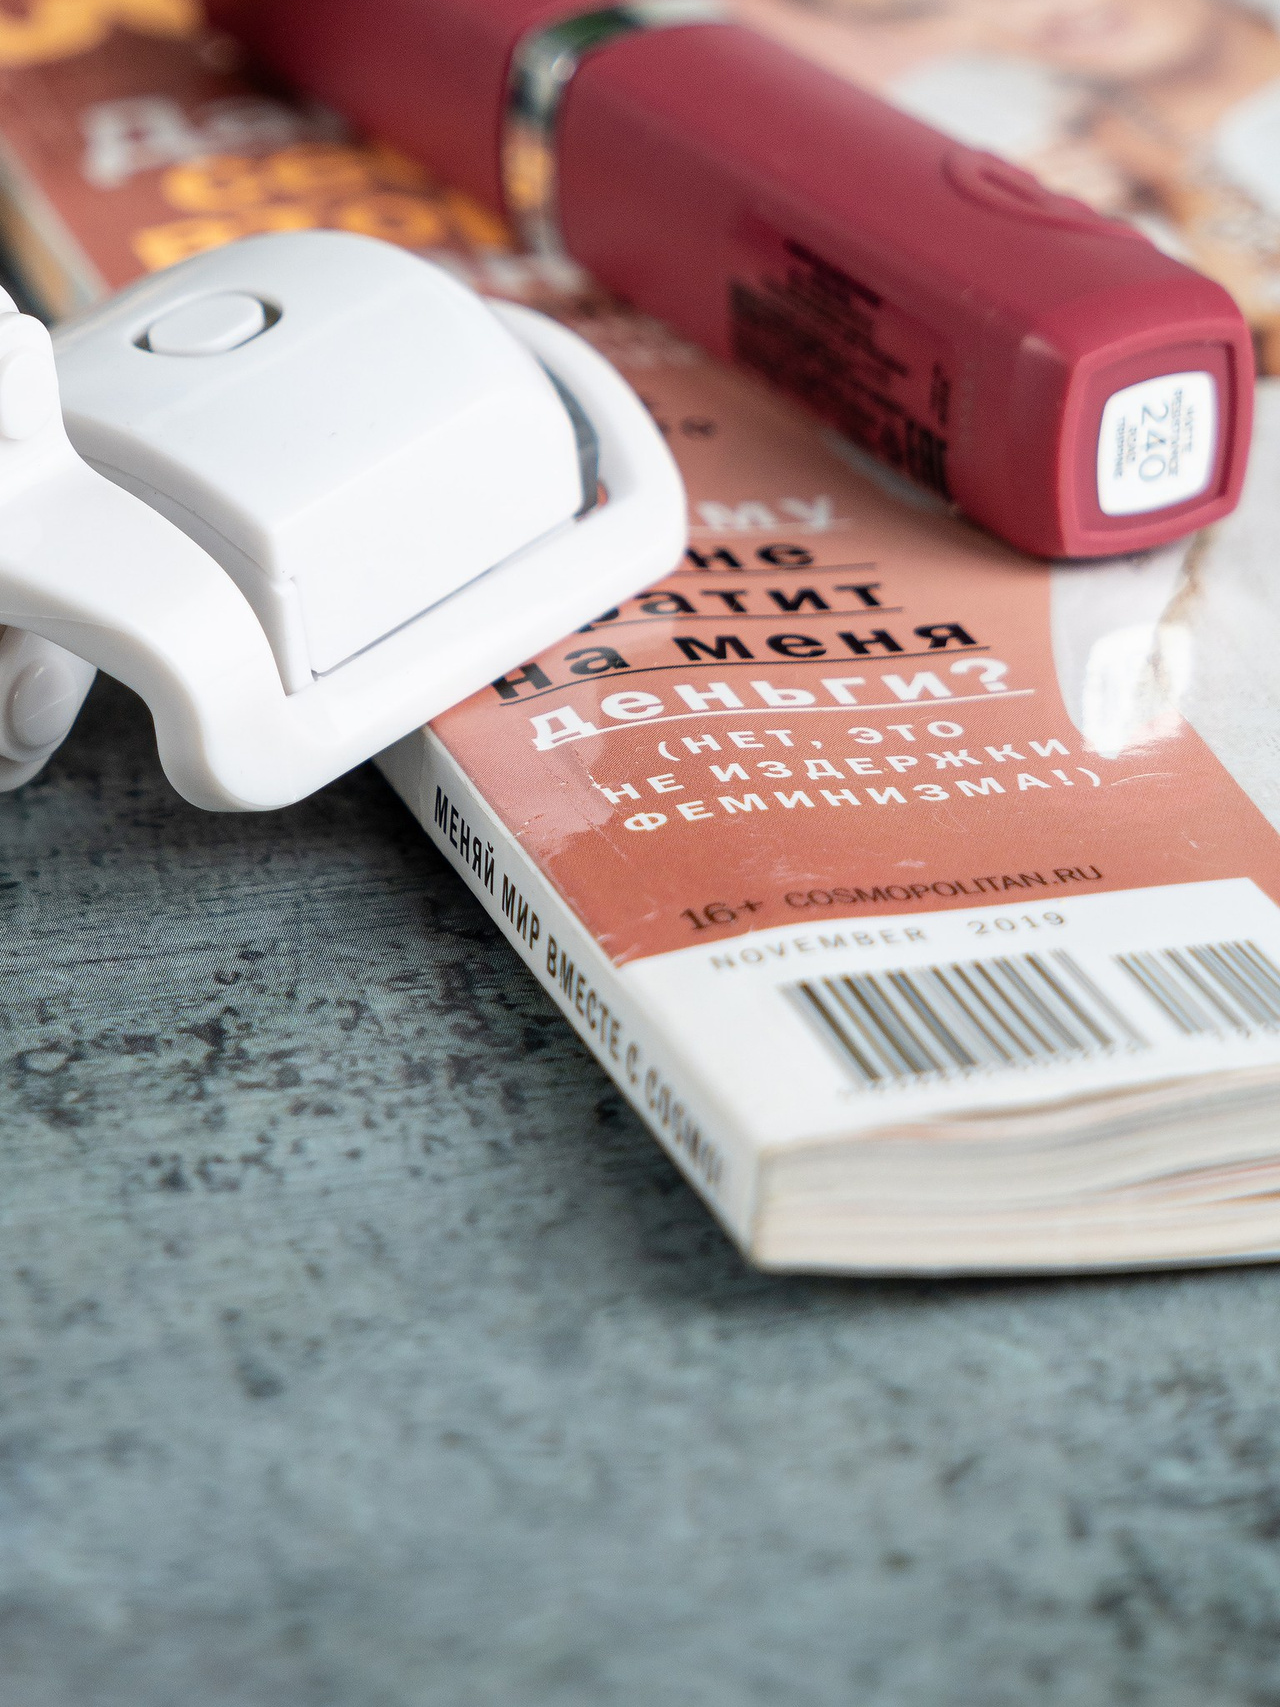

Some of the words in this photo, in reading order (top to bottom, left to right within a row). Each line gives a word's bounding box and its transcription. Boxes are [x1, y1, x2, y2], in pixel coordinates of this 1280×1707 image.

[1138, 398, 1170, 482] 240
[492, 643, 630, 701] на
[673, 623, 979, 662] меня
[602, 772, 684, 805] НЕ
[709, 738, 1071, 782] ИЗДЕРЖКИ
[657, 727, 823, 762] (НЕТ,
[852, 720, 964, 745] ЭТО
[623, 766, 1103, 832] ФЕМИНИЗМА!)
[434, 786, 496, 896] МЕНЯЙ
[501, 873, 541, 951] МИР
[546, 933, 622, 1062] ВМЕСТЕ
[679, 899, 764, 932] 16+
[785, 864, 1104, 910] COSMOPOLITAN.RU
[710, 926, 928, 972] NOVEMBER
[968, 911, 1068, 937] 2019
